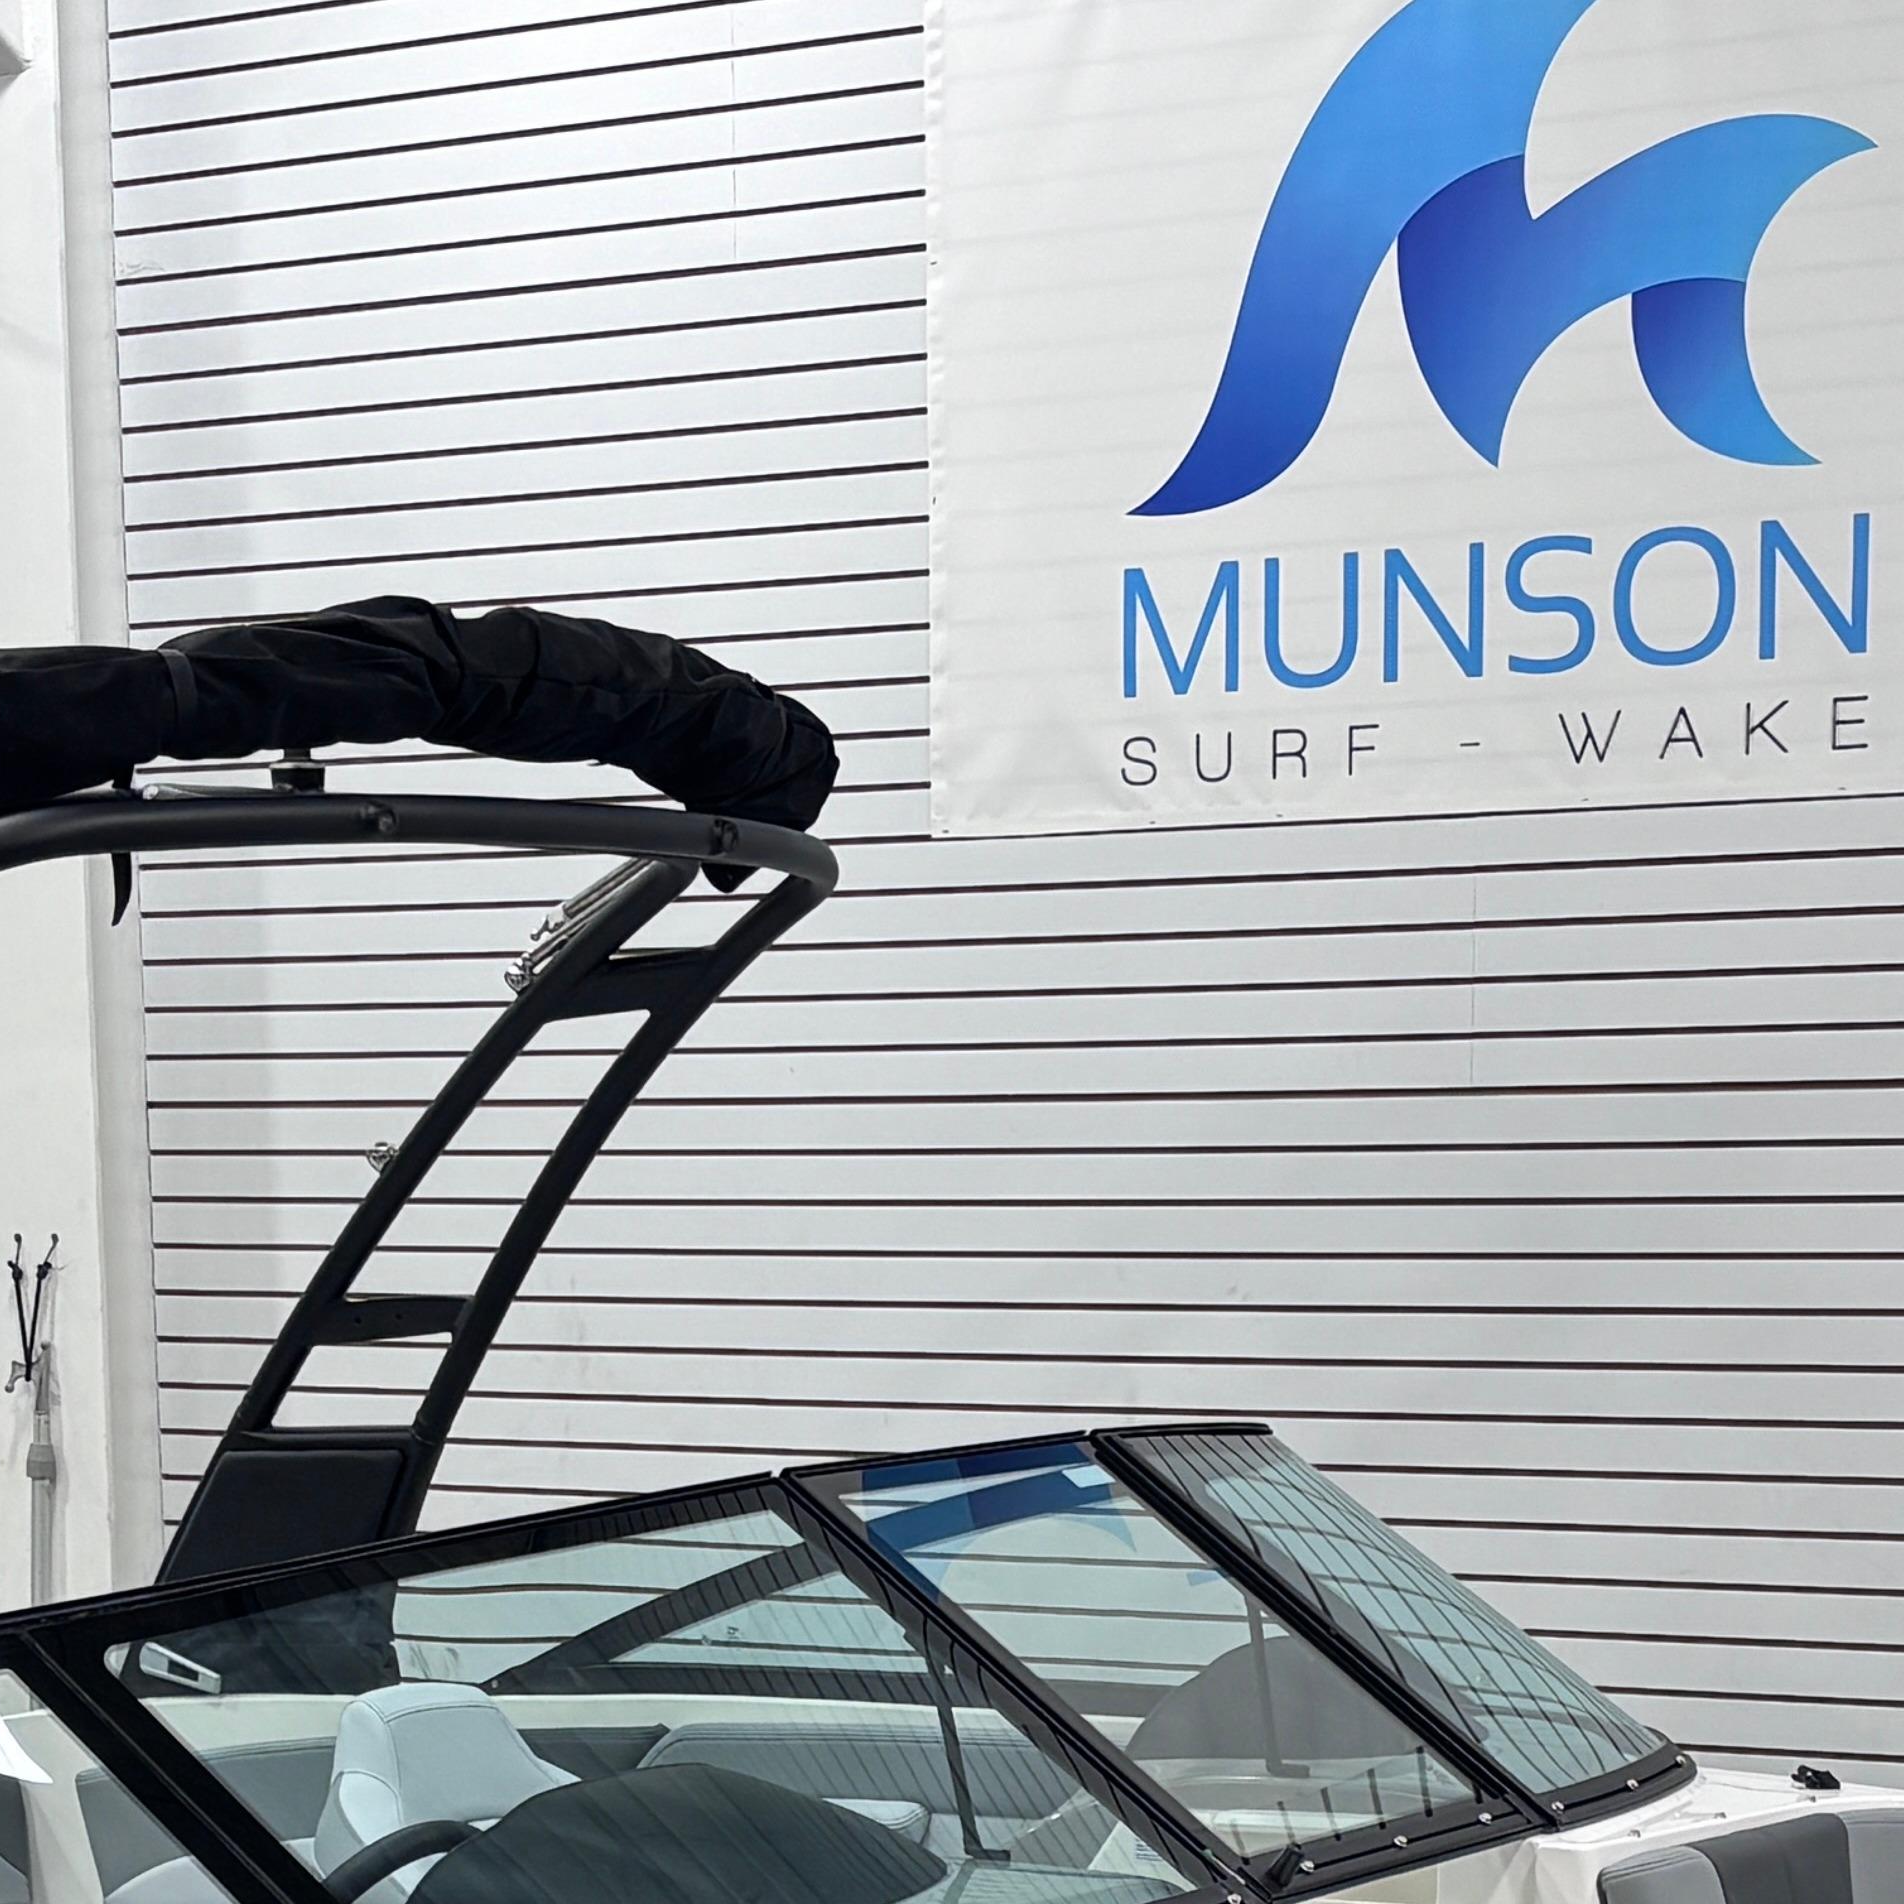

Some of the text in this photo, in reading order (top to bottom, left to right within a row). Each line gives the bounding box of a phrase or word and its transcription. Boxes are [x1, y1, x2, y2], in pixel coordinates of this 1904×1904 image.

[1121, 511, 1871, 698] MUNSON
[1120, 723, 1380, 787] SURF
[1557, 694, 1869, 765] WAKE
